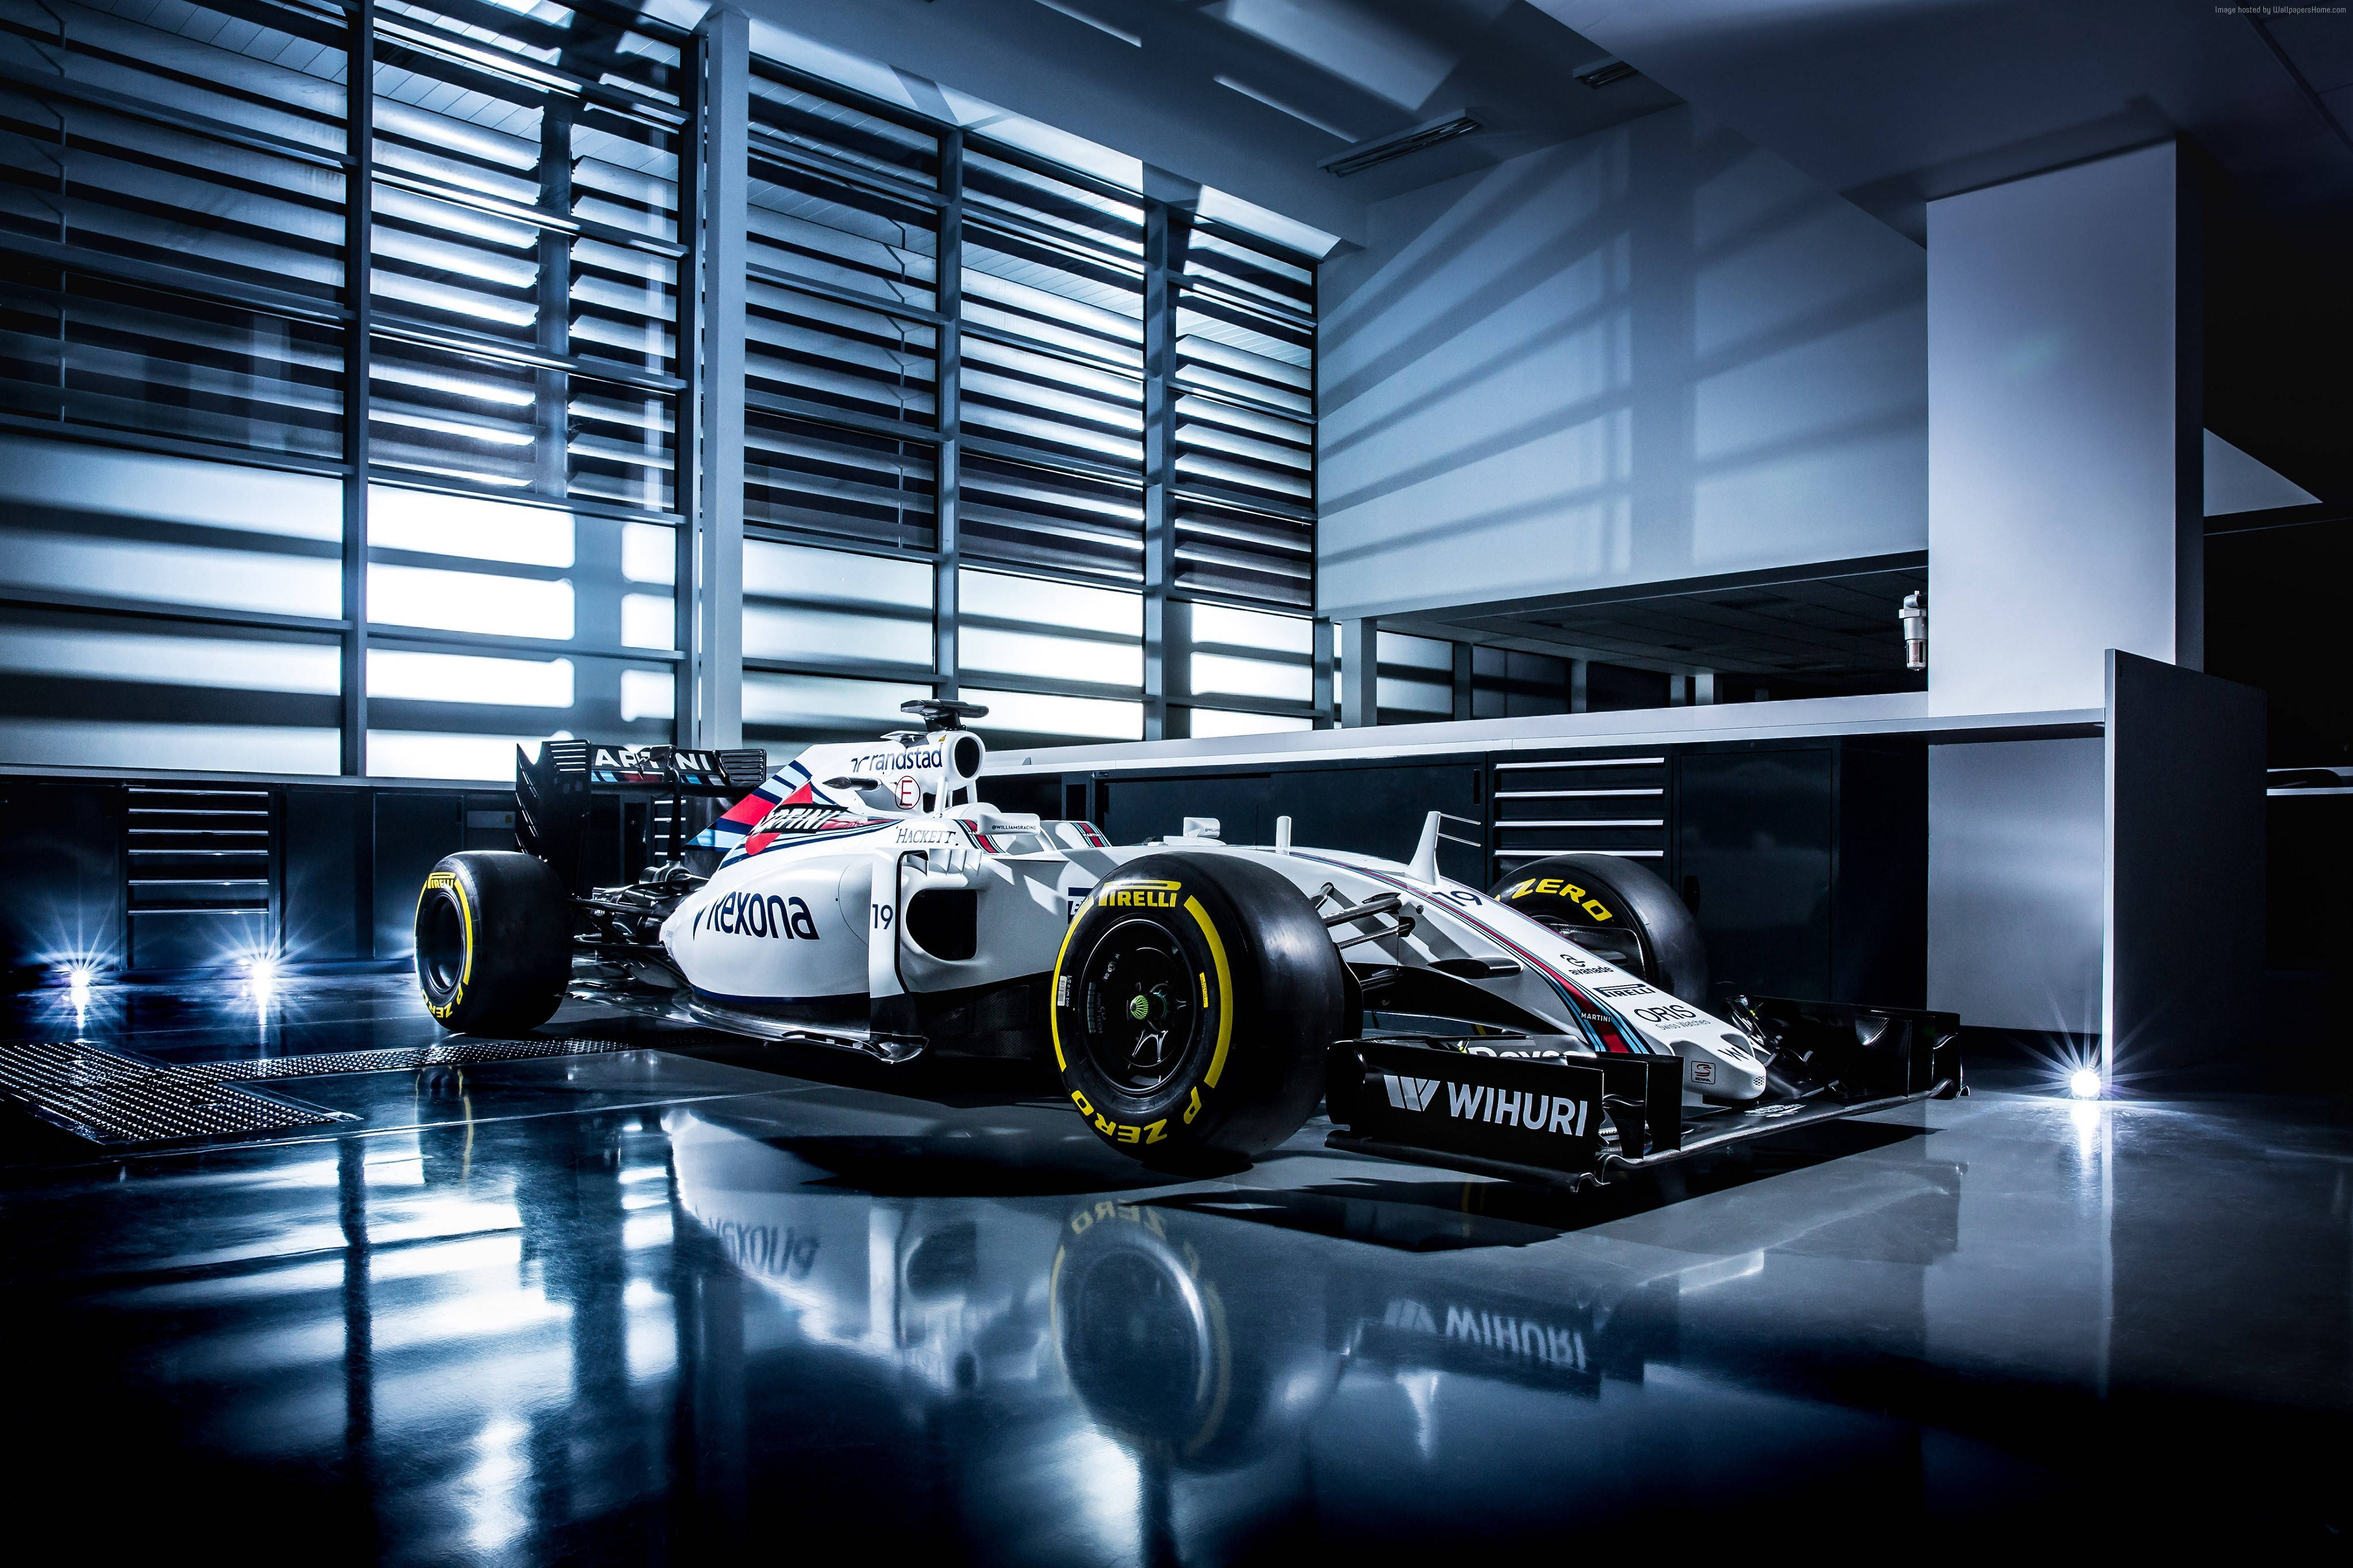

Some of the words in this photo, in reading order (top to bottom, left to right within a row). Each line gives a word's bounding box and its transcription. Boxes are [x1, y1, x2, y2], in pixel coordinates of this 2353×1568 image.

[869, 743, 943, 771] randstad
[899, 780, 912, 806] E
[896, 828, 956, 844] HACKETT
[427, 872, 456, 889] PIRELLI
[1098, 879, 1181, 907] PIRELLI
[1432, 891, 1482, 906] 19
[1511, 878, 1613, 921] ZERO
[872, 903, 893, 930] 19
[1568, 966, 1614, 975] avanade
[1592, 983, 1657, 998] PIRELLI
[1581, 1013, 1611, 1023] MARTINI
[1634, 1005, 1696, 1022] ORIS
[1655, 1022, 1681, 1030] Swiss
[1680, 1019, 1711, 1028] Watches
[1183, 1086, 1202, 1124] P
[1447, 1082, 1587, 1137] WIHURI
[1071, 1090, 1167, 1144] ZERO
